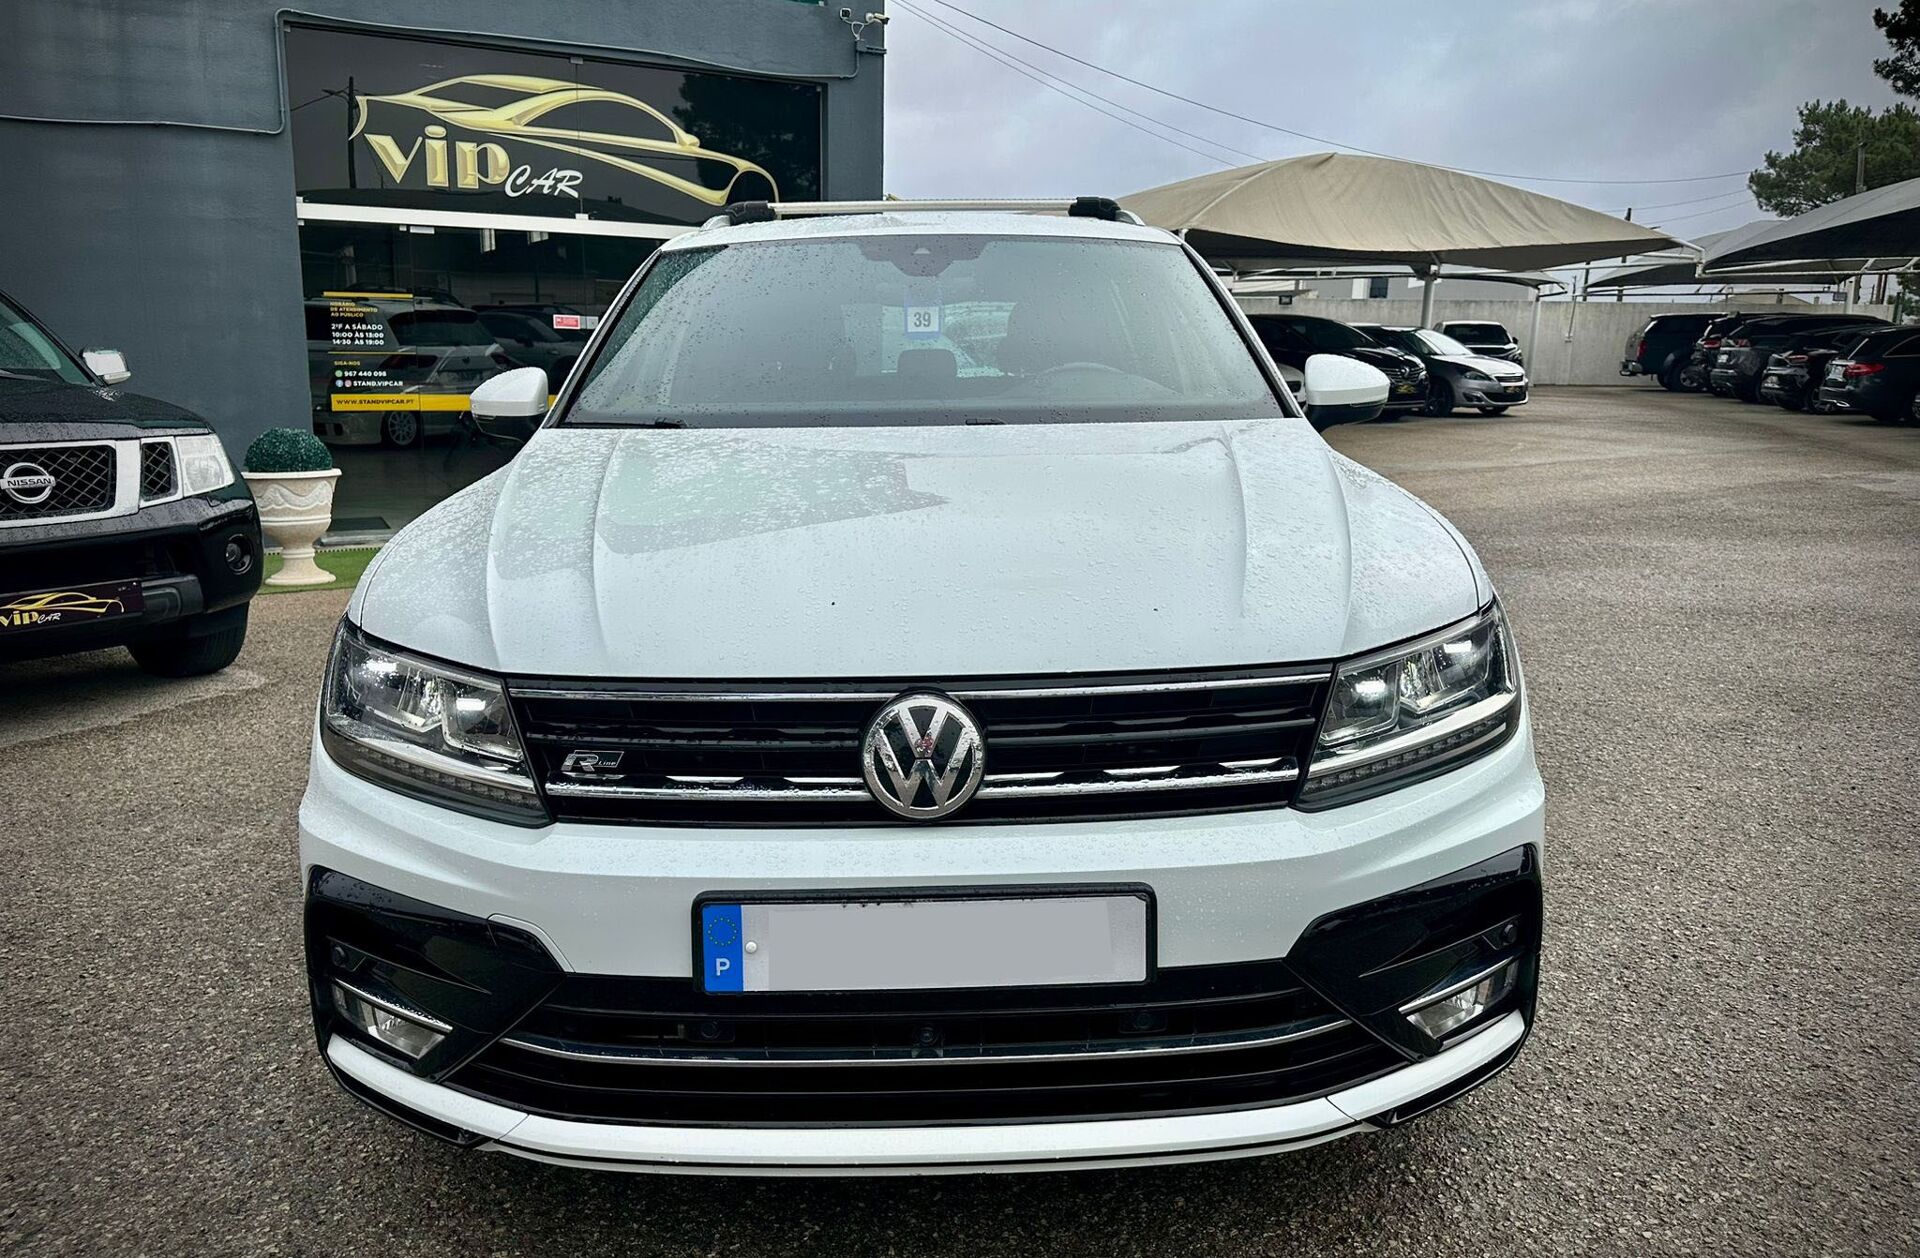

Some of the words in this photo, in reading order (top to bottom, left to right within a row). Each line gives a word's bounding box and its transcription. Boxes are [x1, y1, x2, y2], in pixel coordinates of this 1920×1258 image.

[504, 164, 583, 199] CAR
[352, 322, 383, 331] SÁBADO
[914, 311, 931, 328] 39
[365, 338, 385, 346] 19:00
[7, 478, 52, 487] NISSAN
[561, 753, 599, 772] R
[715, 957, 731, 977] P
